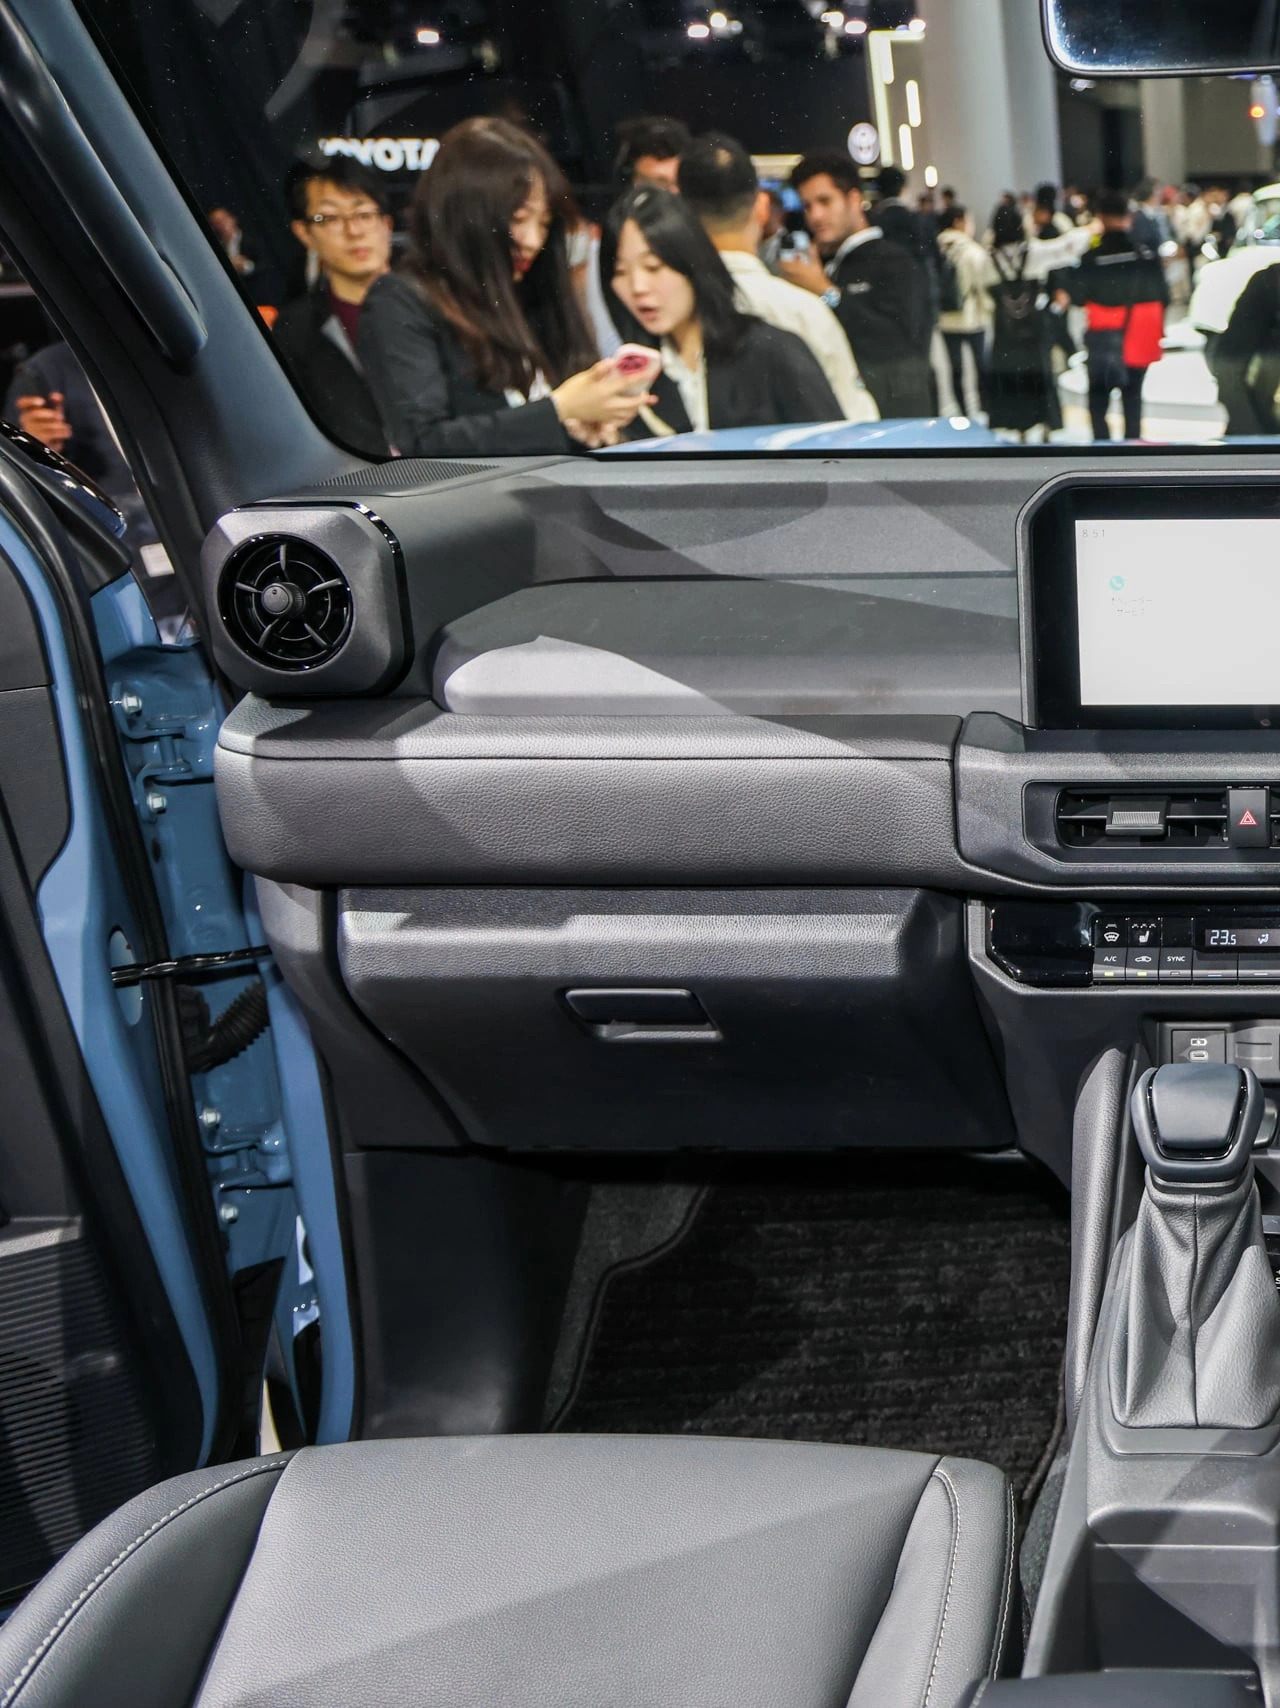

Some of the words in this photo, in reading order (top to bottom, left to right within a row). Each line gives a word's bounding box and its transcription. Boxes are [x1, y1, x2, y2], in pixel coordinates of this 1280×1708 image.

[318, 137, 440, 171] OYOT
[1210, 929, 1237, 945] 23.5
[1103, 955, 1117, 963] A/C
[1166, 955, 1186, 963] SYNC
